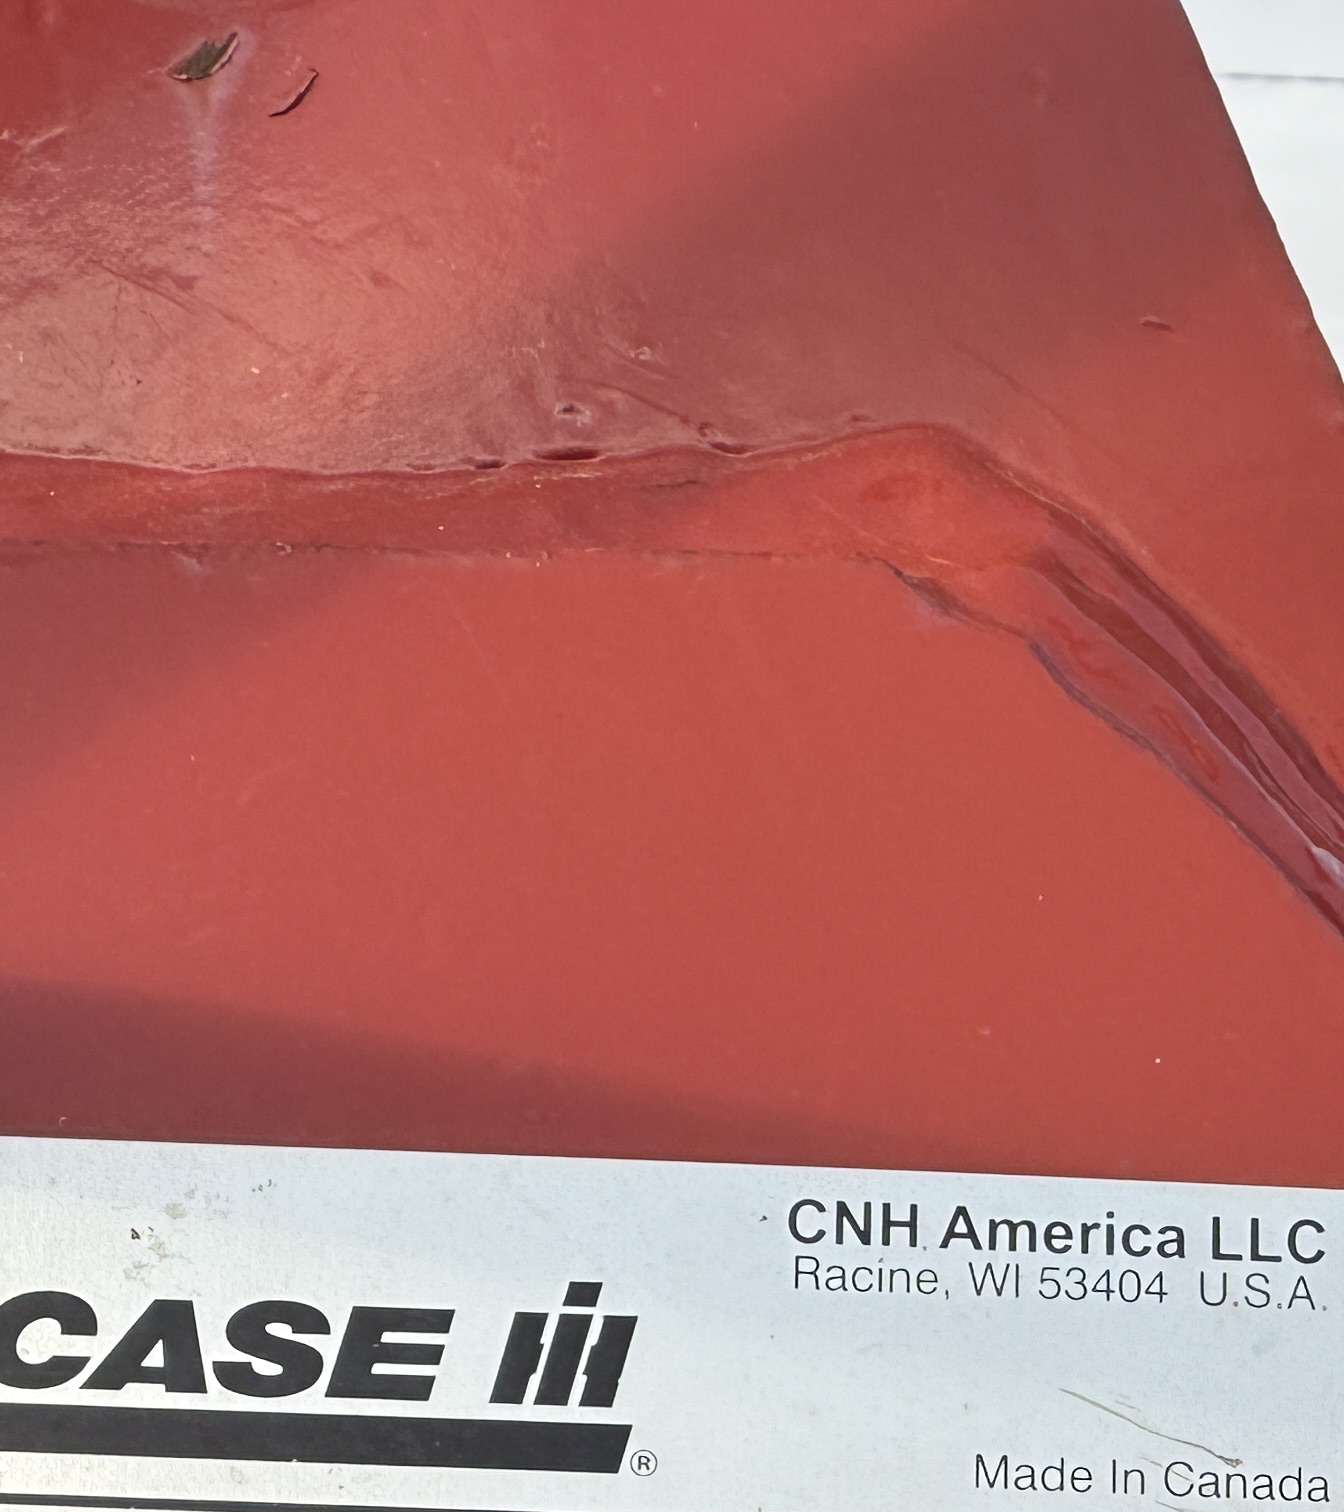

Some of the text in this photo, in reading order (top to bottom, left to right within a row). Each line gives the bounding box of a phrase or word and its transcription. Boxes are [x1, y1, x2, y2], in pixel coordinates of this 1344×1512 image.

[788, 1198, 1327, 1265] CNH America LLC
[793, 1255, 1328, 1312] Racine, WI 53404 U.S.A.
[974, 1454, 1331, 1503] Made In Canada
